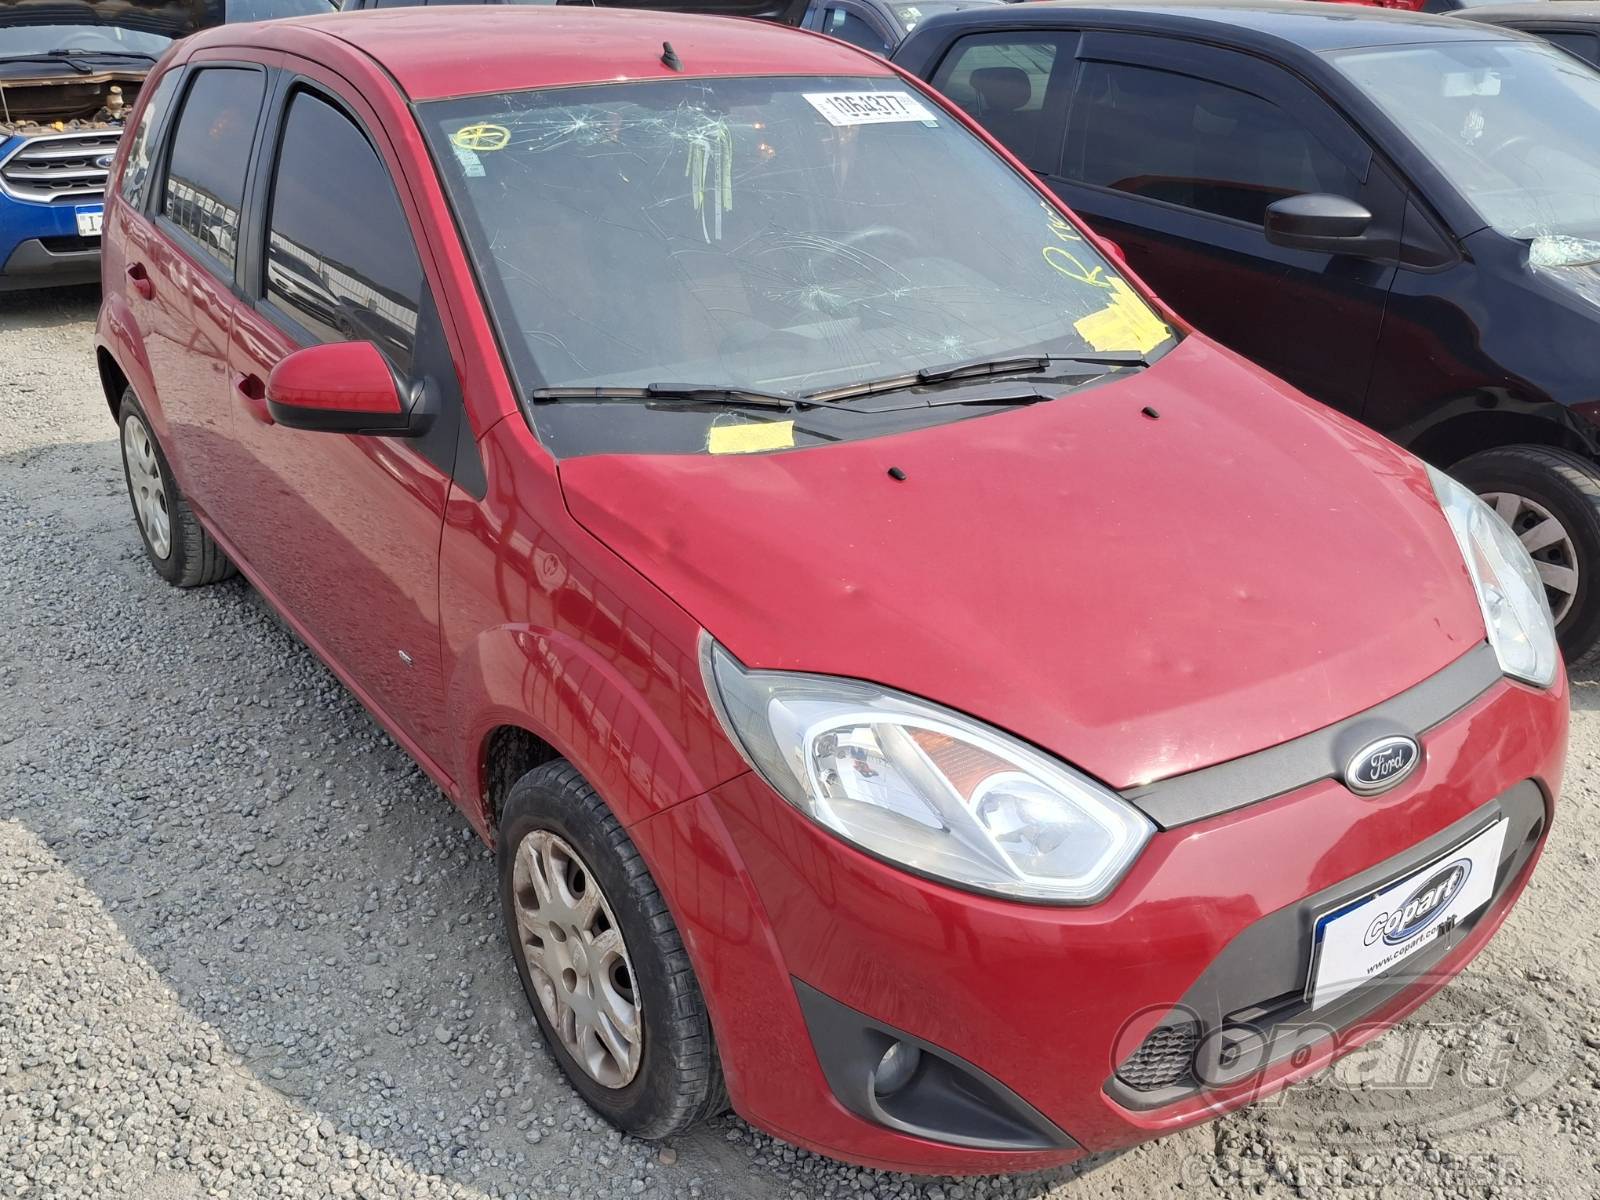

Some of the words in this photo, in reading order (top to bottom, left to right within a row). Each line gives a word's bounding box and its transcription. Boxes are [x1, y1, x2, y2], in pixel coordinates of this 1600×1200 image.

[825, 95, 910, 117] 1064377
[1370, 747, 1404, 780] Ford
[1363, 864, 1461, 947] Copart
